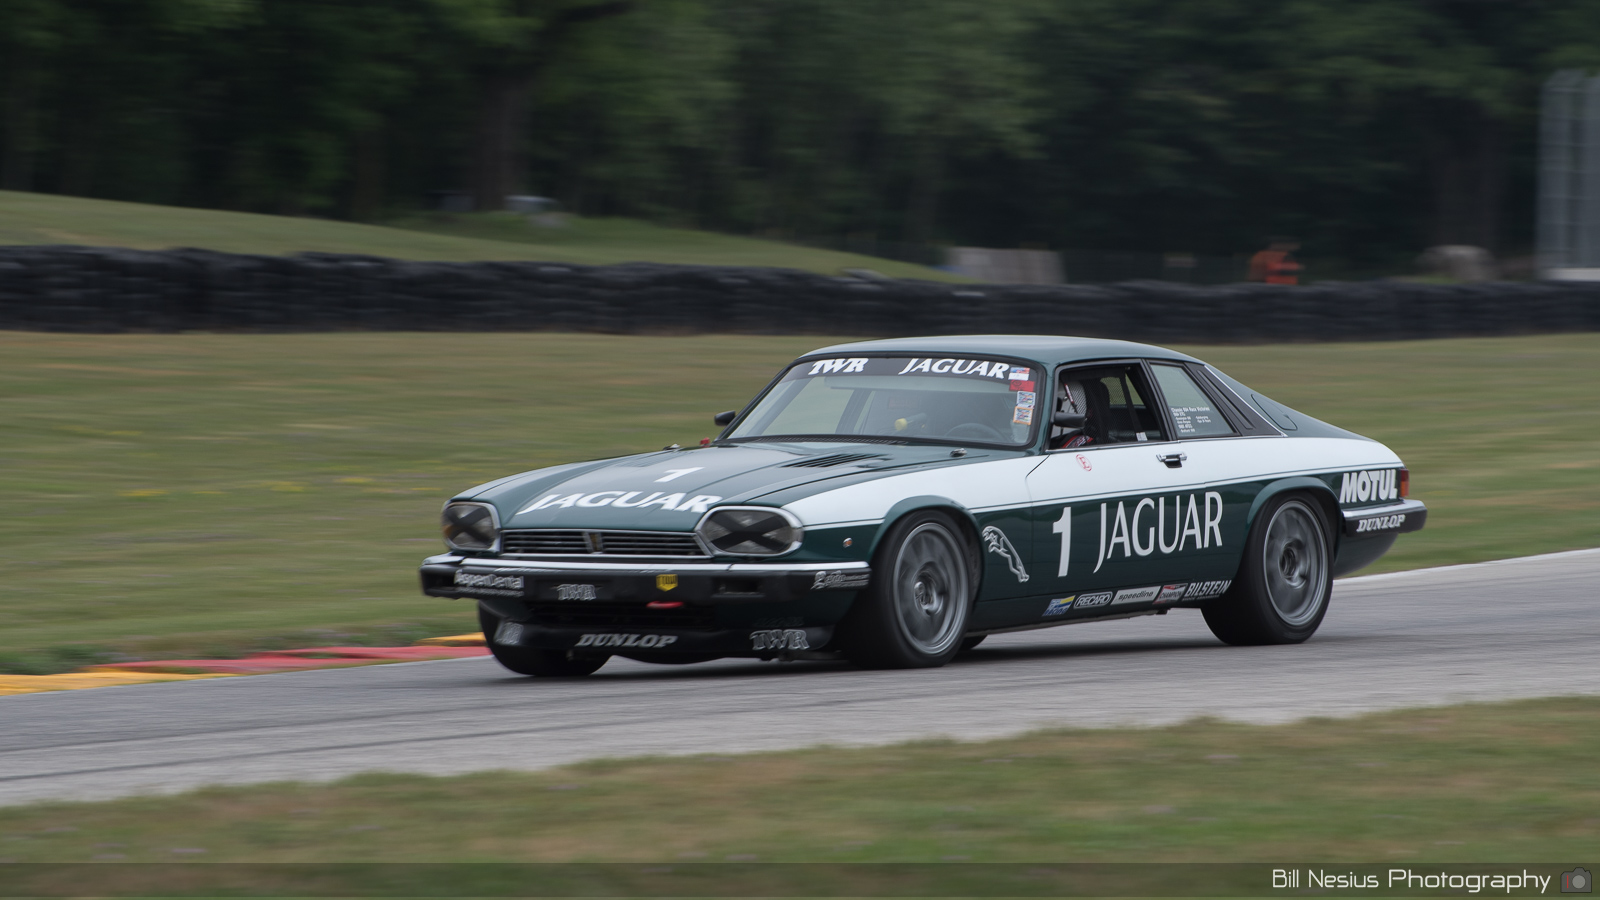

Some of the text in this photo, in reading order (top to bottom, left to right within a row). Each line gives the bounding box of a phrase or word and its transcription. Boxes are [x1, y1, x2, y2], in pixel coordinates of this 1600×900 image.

[808, 358, 868, 375] TWR
[898, 358, 1009, 379] JAGUAR
[653, 467, 705, 482] 1
[1339, 469, 1398, 503] MOTUL
[515, 491, 722, 514] JAGUAR
[1356, 514, 1406, 532] DUNLOP
[1052, 491, 1223, 577] 1 JAGUAR
[1118, 590, 1154, 601] speedline
[1183, 580, 1232, 598] BILSTEIN
[1076, 594, 1112, 607] RECARO
[575, 633, 678, 648] DUNLOP
[749, 629, 810, 650] TWR
